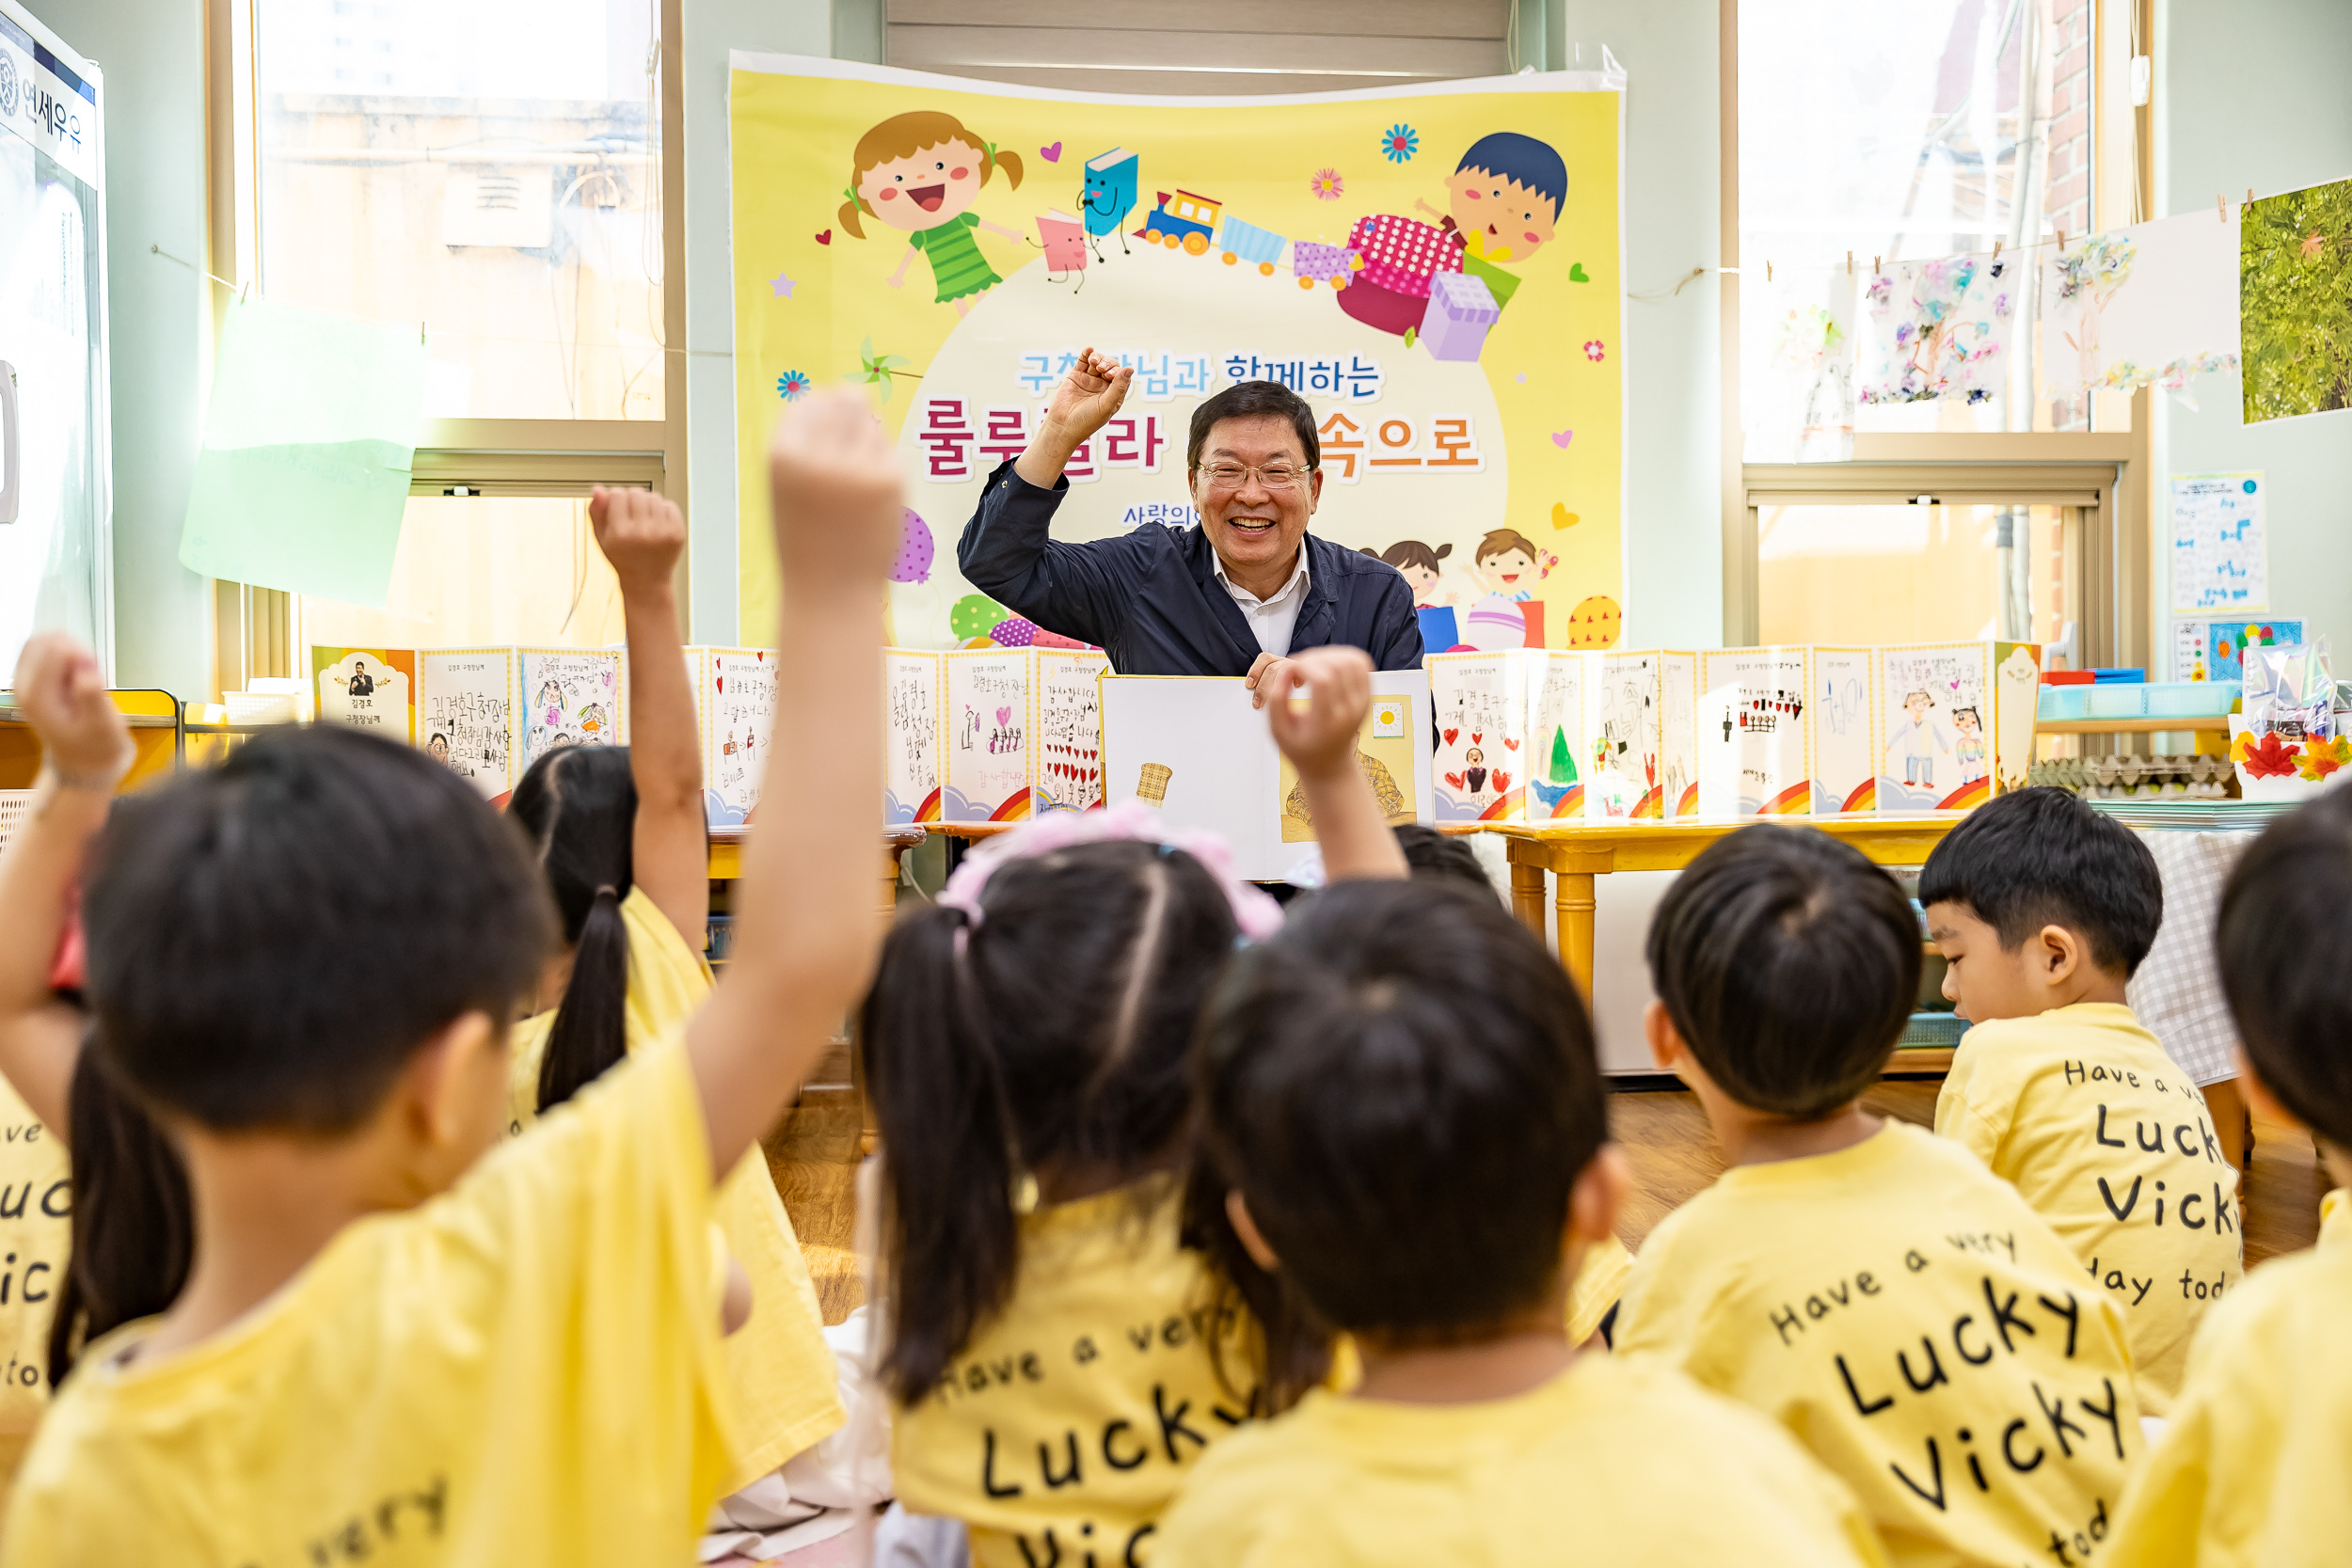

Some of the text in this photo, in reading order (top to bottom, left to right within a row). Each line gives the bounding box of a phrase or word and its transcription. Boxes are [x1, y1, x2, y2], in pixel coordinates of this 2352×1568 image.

[23, 78, 82, 154] 연세우유
[1020, 353, 1210, 395] 구님과
[1317, 413, 1479, 478] 속으로
[1123, 503, 1201, 526] 사랑의
[2064, 1059, 2205, 1107] Have a ve
[2096, 1103, 2223, 1164] Luck
[2097, 1175, 2246, 1260] Vick
[1768, 1229, 2017, 1349] Have a very
[2179, 1268, 2235, 1303] tod
[1072, 1334, 1100, 1366] a
[1833, 1275, 2079, 1418] Lucky
[1889, 1376, 2125, 1513] Vicky
[1013, 1520, 1158, 1568] Vic
[2047, 1497, 2111, 1568] tod
